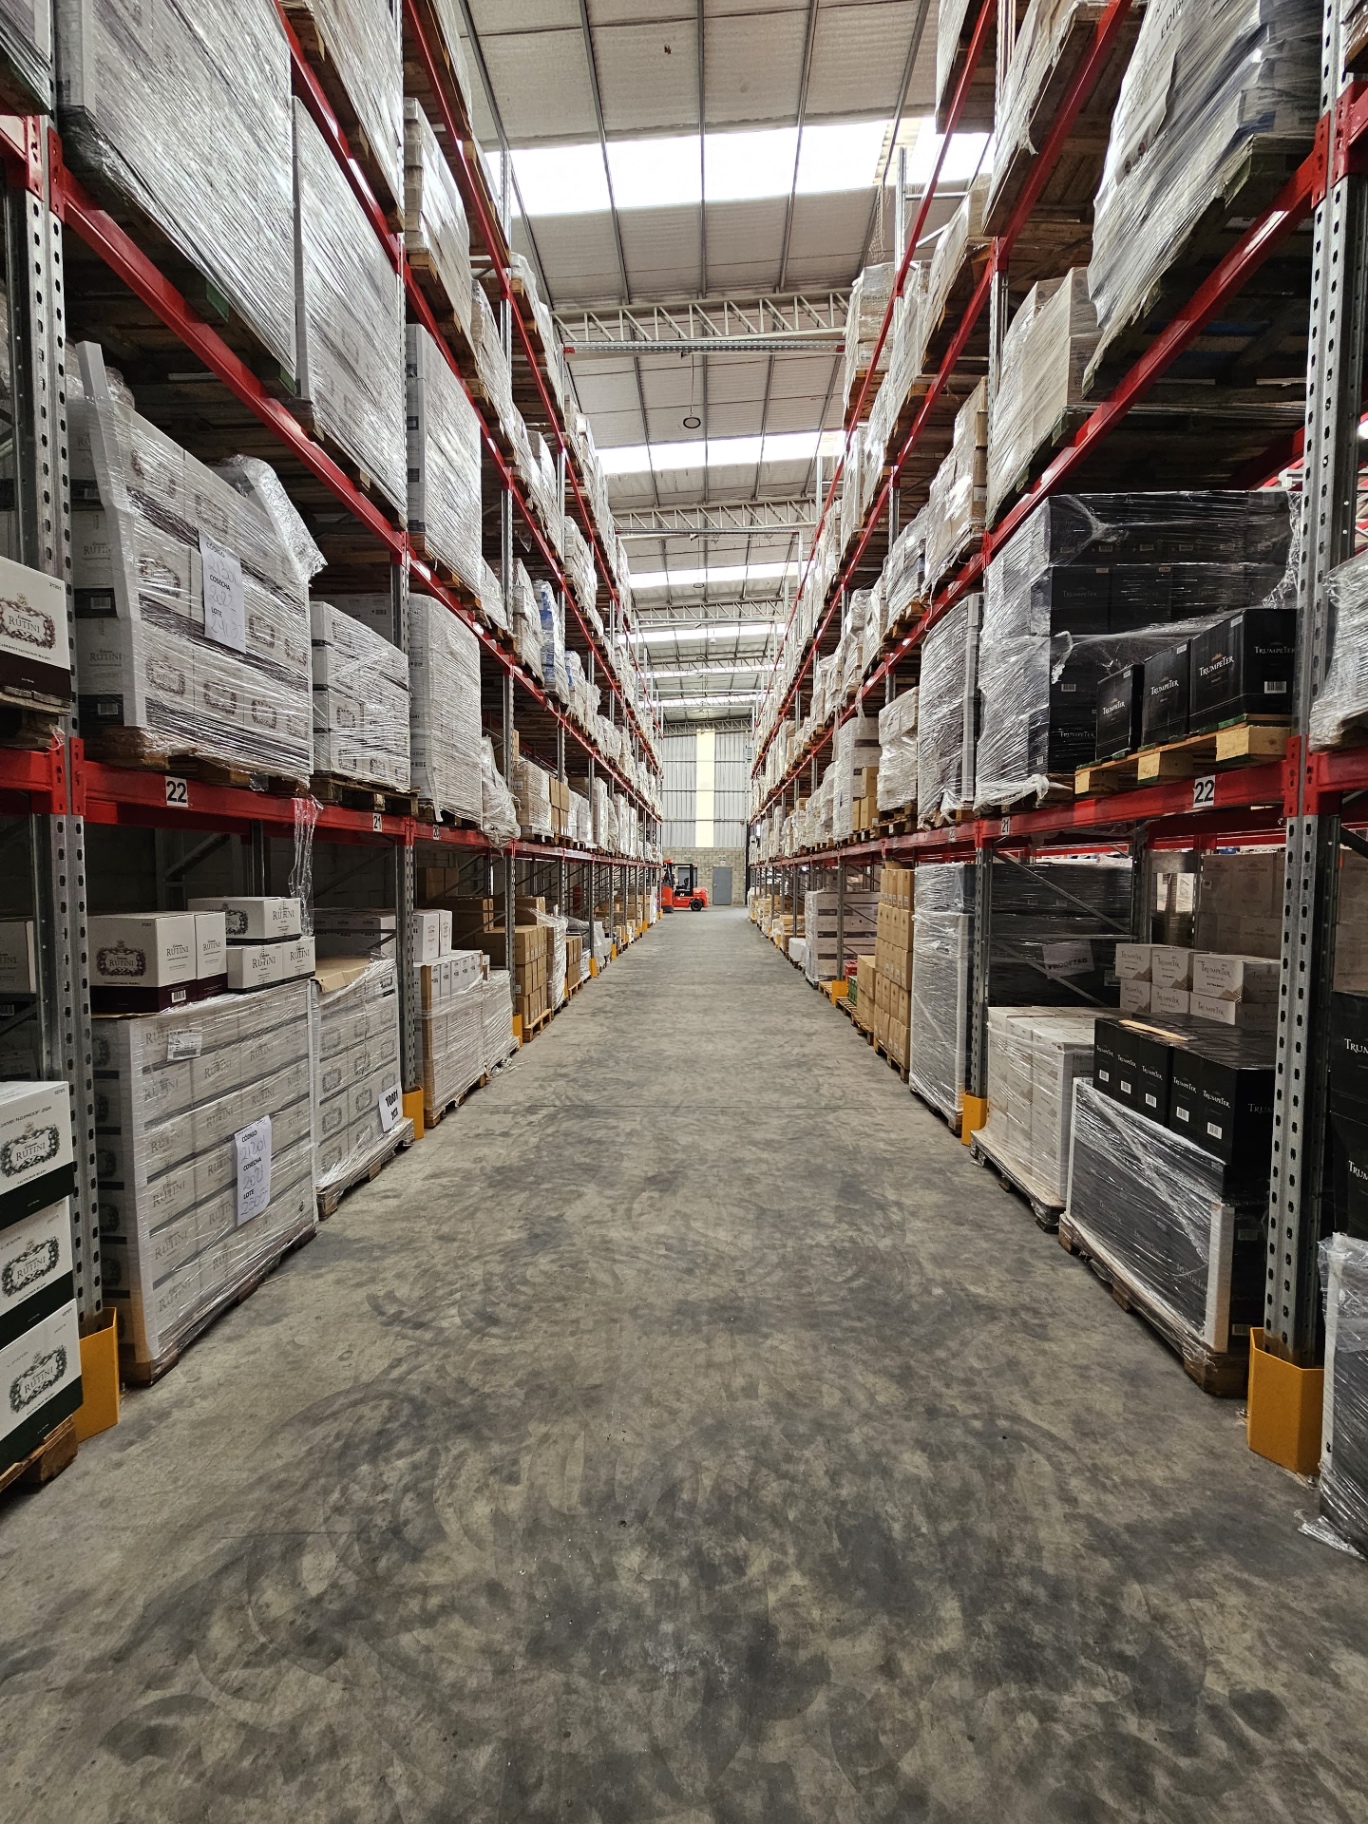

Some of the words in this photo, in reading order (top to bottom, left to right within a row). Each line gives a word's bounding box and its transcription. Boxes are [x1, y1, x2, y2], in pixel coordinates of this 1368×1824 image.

[1161, 0, 1184, 39] EDIB
[209, 574, 231, 591] COSECHA
[211, 606, 223, 617] LOTE
[8, 614, 41, 634] RUTINI
[90, 652, 122, 662] RUTINI
[166, 780, 187, 804] 22
[1195, 780, 1214, 803] 22
[373, 815, 382, 830] 21
[1001, 819, 1010, 833] 21
[166, 946, 189, 957] RUTINI
[203, 941, 221, 952] RUTINI
[109, 959, 134, 968] RUTINI
[252, 956, 276, 969] RUTINI
[16, 1142, 46, 1161] RUTINI
[243, 1156, 262, 1171] COSECHA
[243, 1188, 255, 1200] LOTE
[17, 1256, 46, 1279] RUTINI
[24, 1366, 53, 1394] RUTINI
